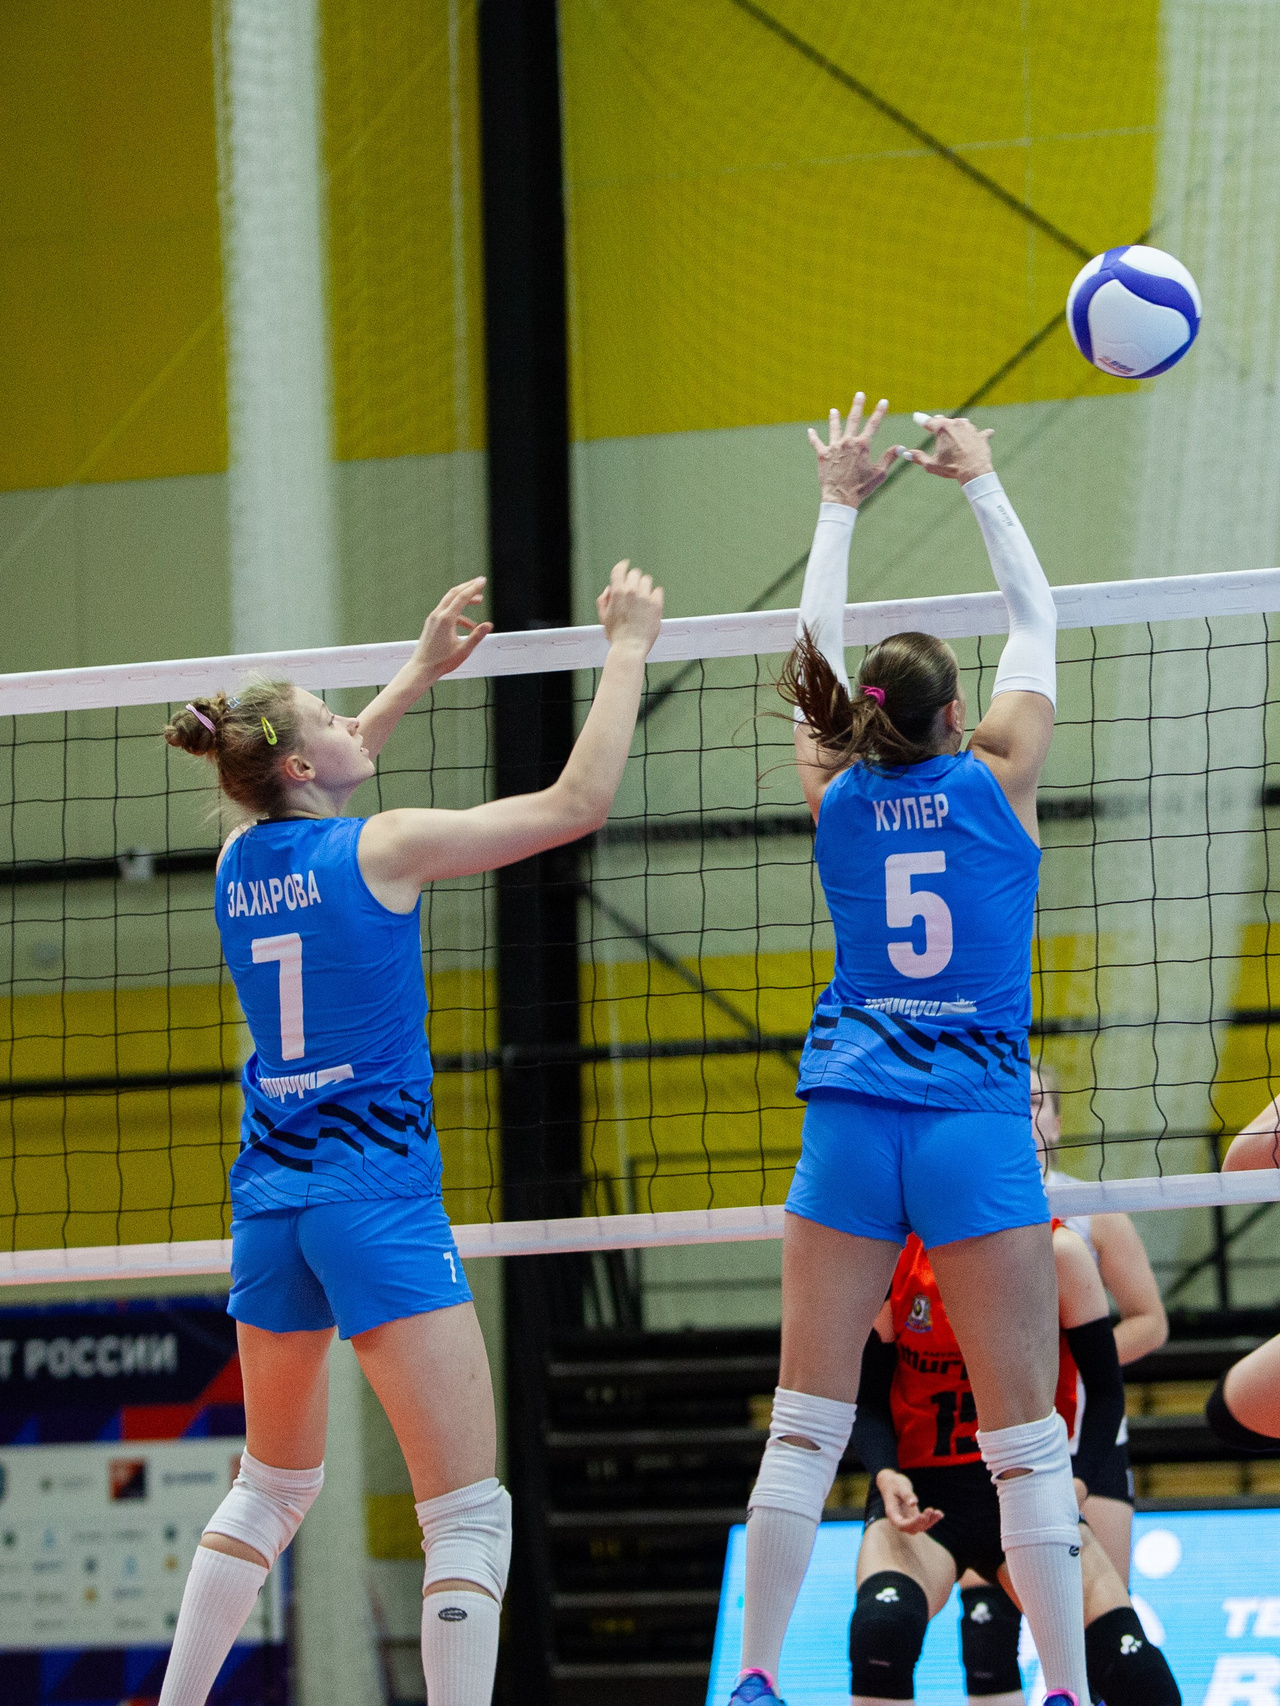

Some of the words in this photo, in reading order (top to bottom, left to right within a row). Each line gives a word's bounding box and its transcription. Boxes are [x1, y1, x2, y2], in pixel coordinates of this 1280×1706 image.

[872, 793, 949, 831] КУПЕР
[228, 870, 322, 918] ЗАХАРОВА
[885, 850, 953, 979] 5
[251, 932, 305, 1061] 7
[443, 1251, 457, 1283] 7
[24, 1333, 178, 1380] РОССИИ
